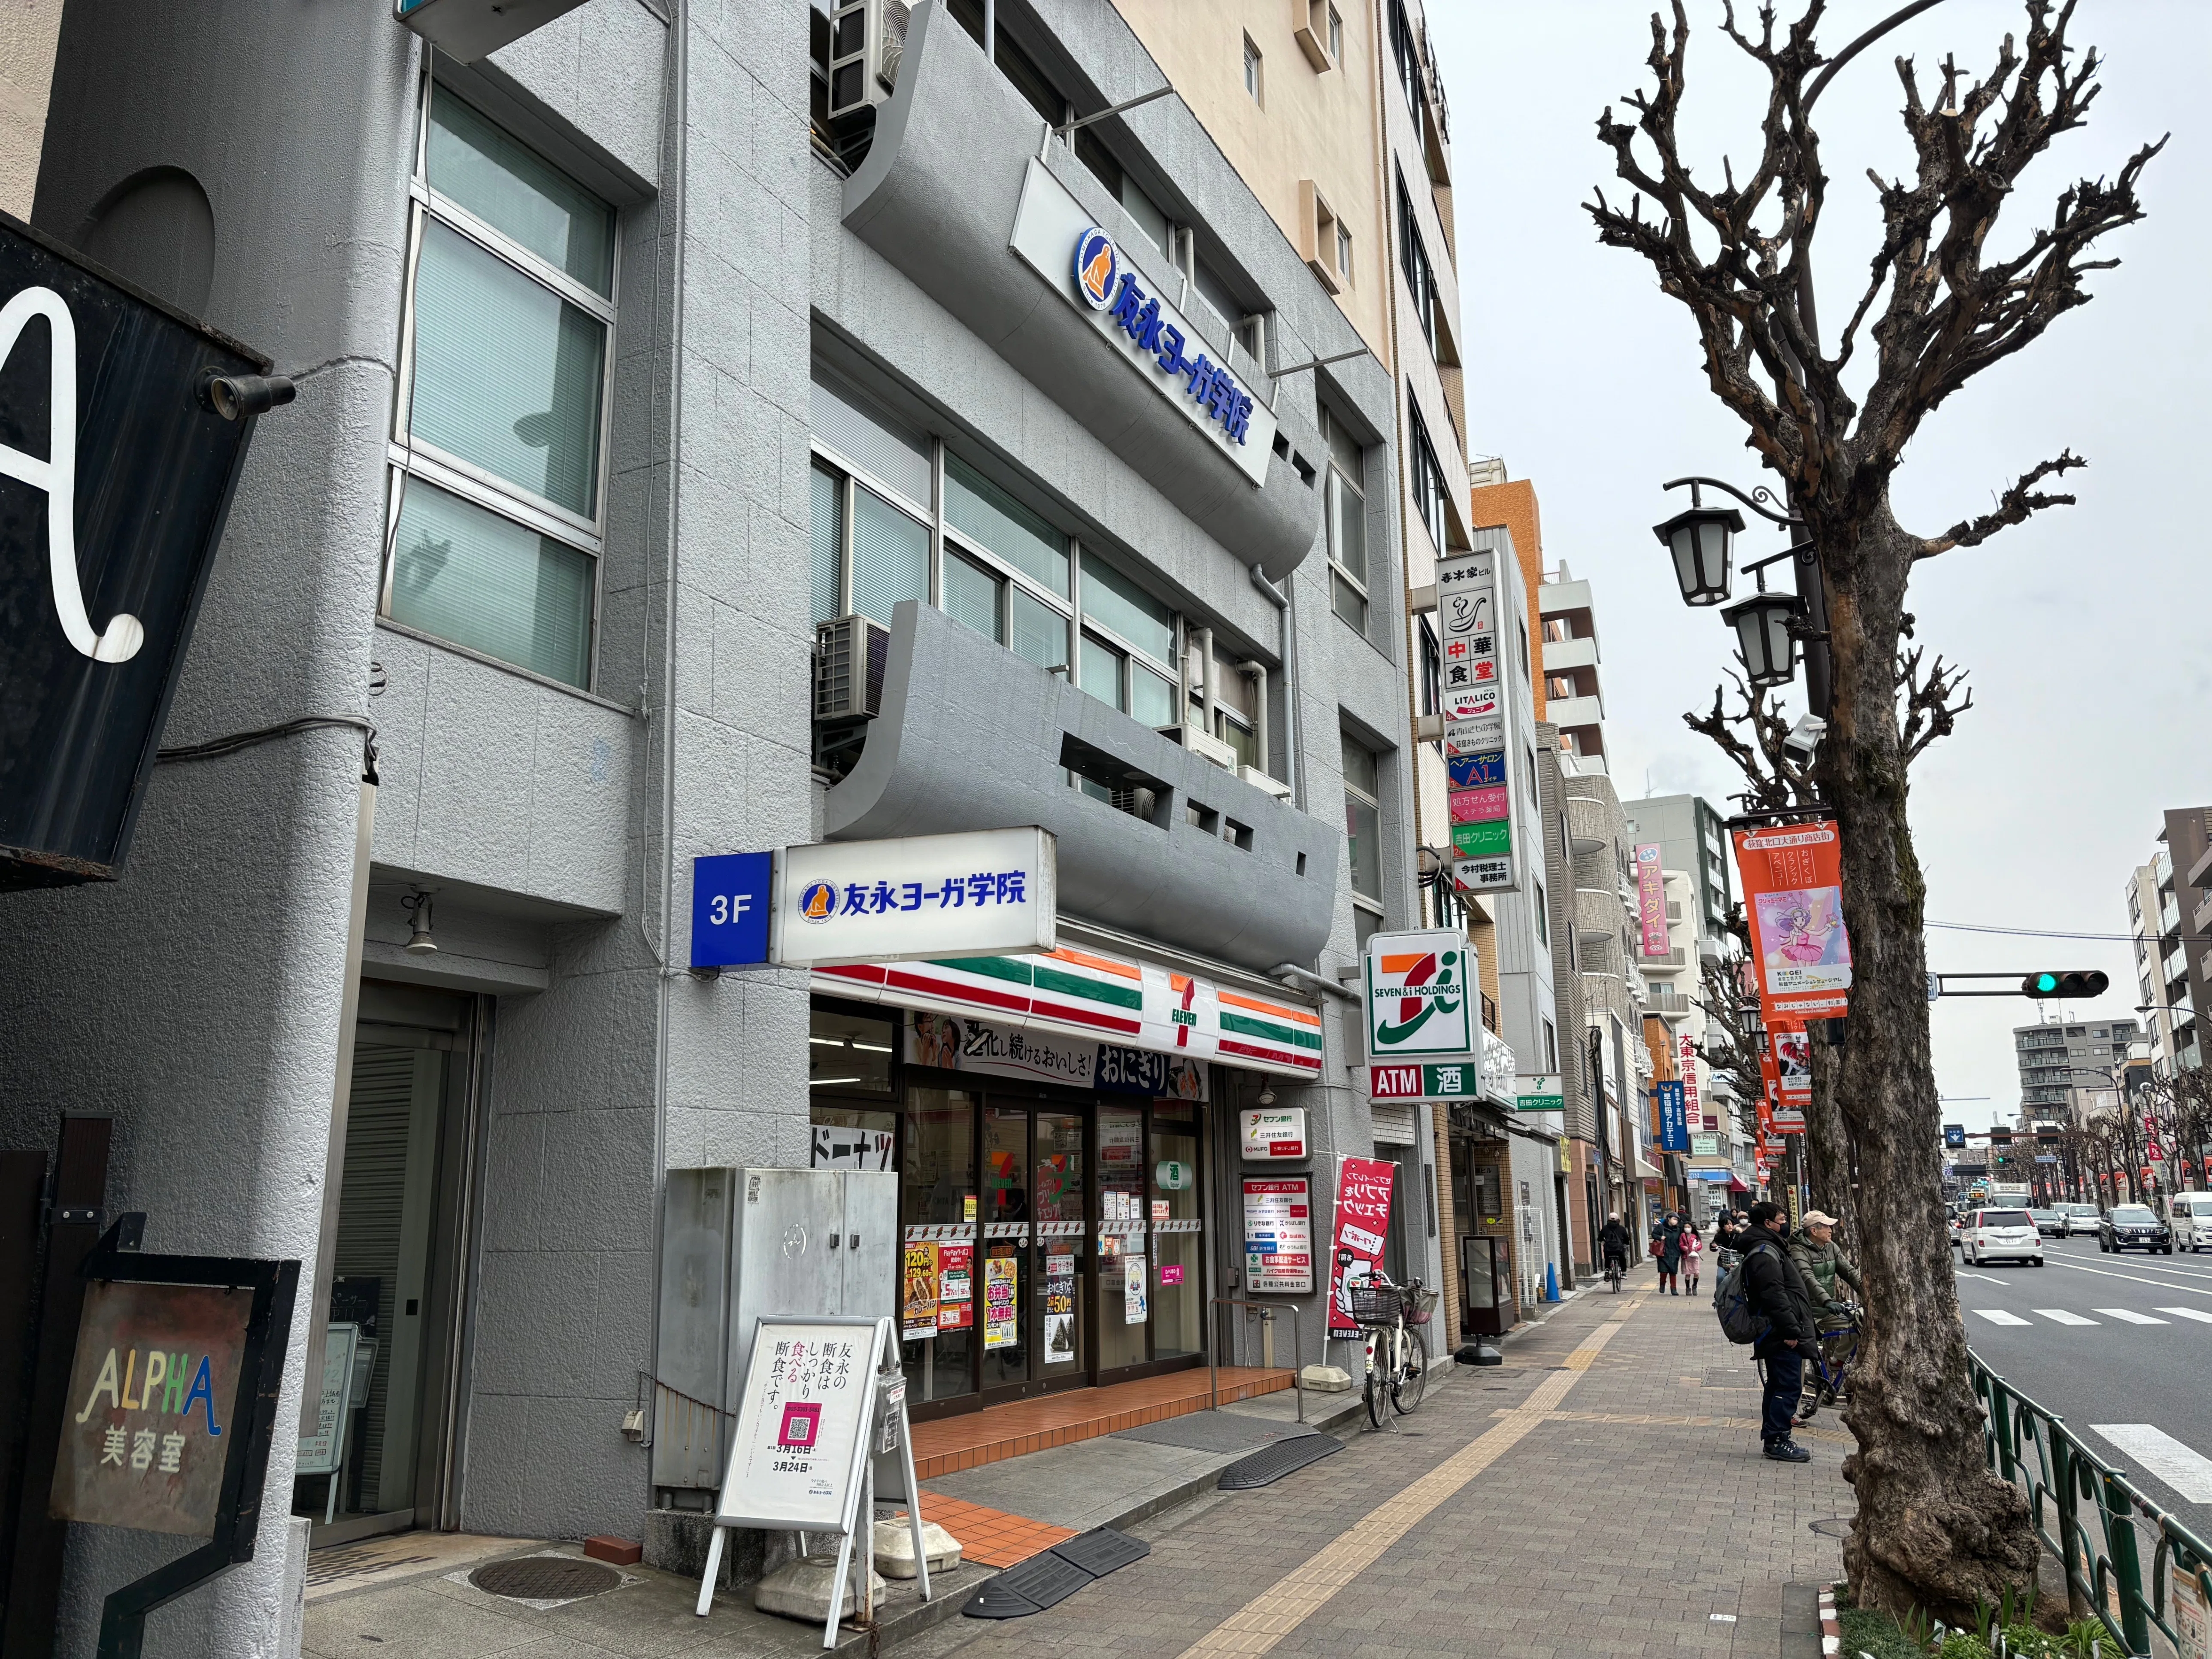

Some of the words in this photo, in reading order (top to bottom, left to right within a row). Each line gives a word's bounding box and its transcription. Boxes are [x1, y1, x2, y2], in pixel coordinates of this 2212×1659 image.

[1079, 229, 1101, 264] TOMONAGA
[1103, 231, 1115, 249] YOGA
[1109, 273, 1254, 446] 友永ヨーガ学院
[1448, 637, 1492, 658] 中華
[1449, 661, 1494, 684] 食堂
[1455, 692, 1495, 705] LITALICO
[1456, 735, 1502, 748] 荻窪きものクリニック
[1451, 754, 1502, 767] ヘアーサロン
[1466, 764, 1489, 785] A1
[1453, 792, 1505, 807] 処方せん受付
[1463, 805, 1500, 816] ステラ薬局
[1455, 829, 1507, 845] 吉田クリニック
[1747, 833, 1830, 848] 荻窪北口大通り商店街
[1462, 862, 1506, 873] 今村税理士
[1480, 872, 1507, 883] 事務所
[1773, 852, 1783, 886] アベニュー
[1787, 851, 1798, 885] クラシック
[1801, 849, 1813, 884] おぎくぼ
[840, 870, 1026, 916] 友永ヨーガ学院
[1642, 865, 1661, 928] アキダイ
[710, 894, 752, 925] 3F
[1415, 985, 1461, 995] HOLDINGS
[1779, 978, 1842, 987] 杉並アニメーションミュージアム
[1101, 1044, 1165, 1090] おにぎり
[1679, 1033, 1700, 1124] 大東京信用組合
[1377, 1069, 1417, 1094] ATM
[1436, 1067, 1462, 1093] 酒
[1664, 1093, 1674, 1147] 早稲田アカデミー
[810, 1128, 892, 1171] ドーナツ
[1170, 1164, 1179, 1181] 酒
[987, 1284, 1009, 1301] お弁当
[1047, 1281, 1069, 1294] おにぎり
[914, 1299, 936, 1316] カレーパン
[987, 1305, 1012, 1322] 1本無料
[788, 1342, 806, 1383] 食べる
[802, 1342, 819, 1400] しっかり
[818, 1342, 837, 1390] 断食は
[833, 1342, 853, 1390] 友永の
[767, 1341, 790, 1410] 断食です。
[76, 1348, 221, 1436] ALPHA
[101, 1425, 185, 1474] 美容室
[776, 1444, 811, 1454] 3月16日
[773, 1462, 808, 1473] 3月24日
